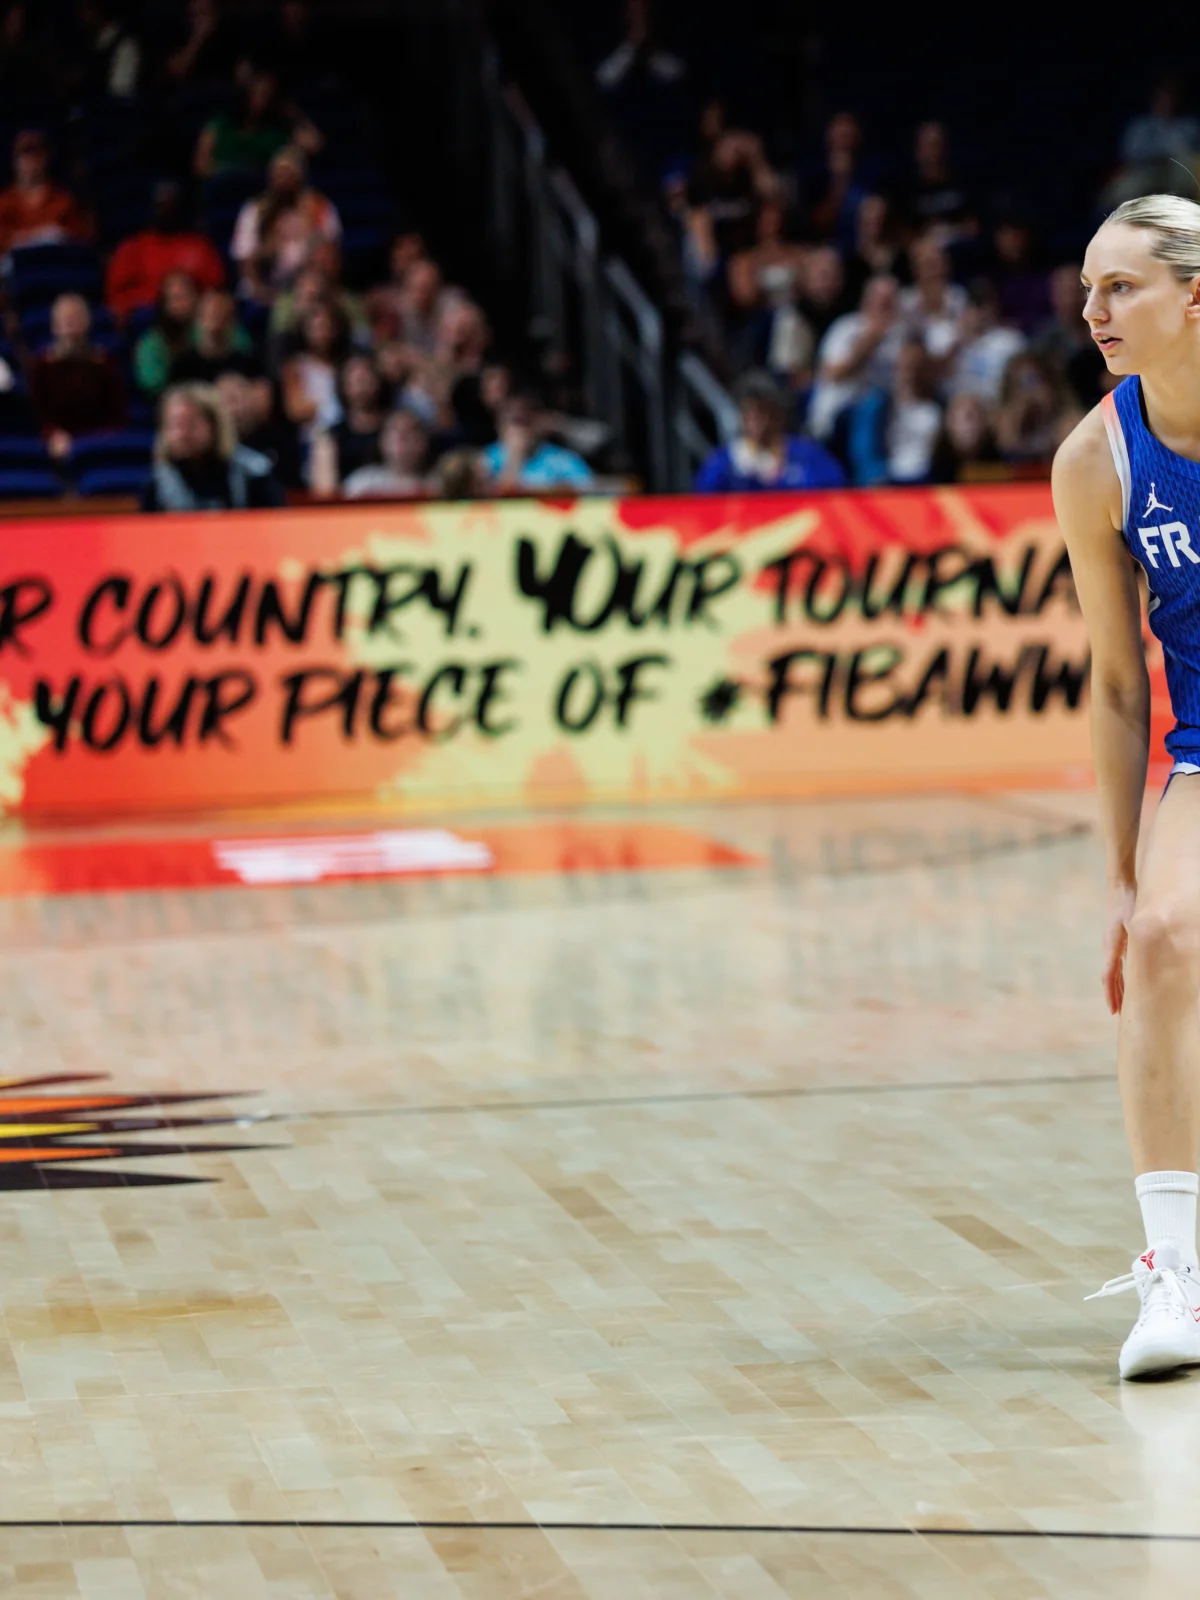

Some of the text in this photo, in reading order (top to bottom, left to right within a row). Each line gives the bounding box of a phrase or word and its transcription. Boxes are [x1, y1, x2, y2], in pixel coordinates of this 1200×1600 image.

[77, 561, 482, 656] COUNTRY.
[515, 531, 744, 634] YOUR
[33, 669, 258, 755] YOUR
[279, 662, 519, 746] PIECE
[554, 648, 672, 732] OF
